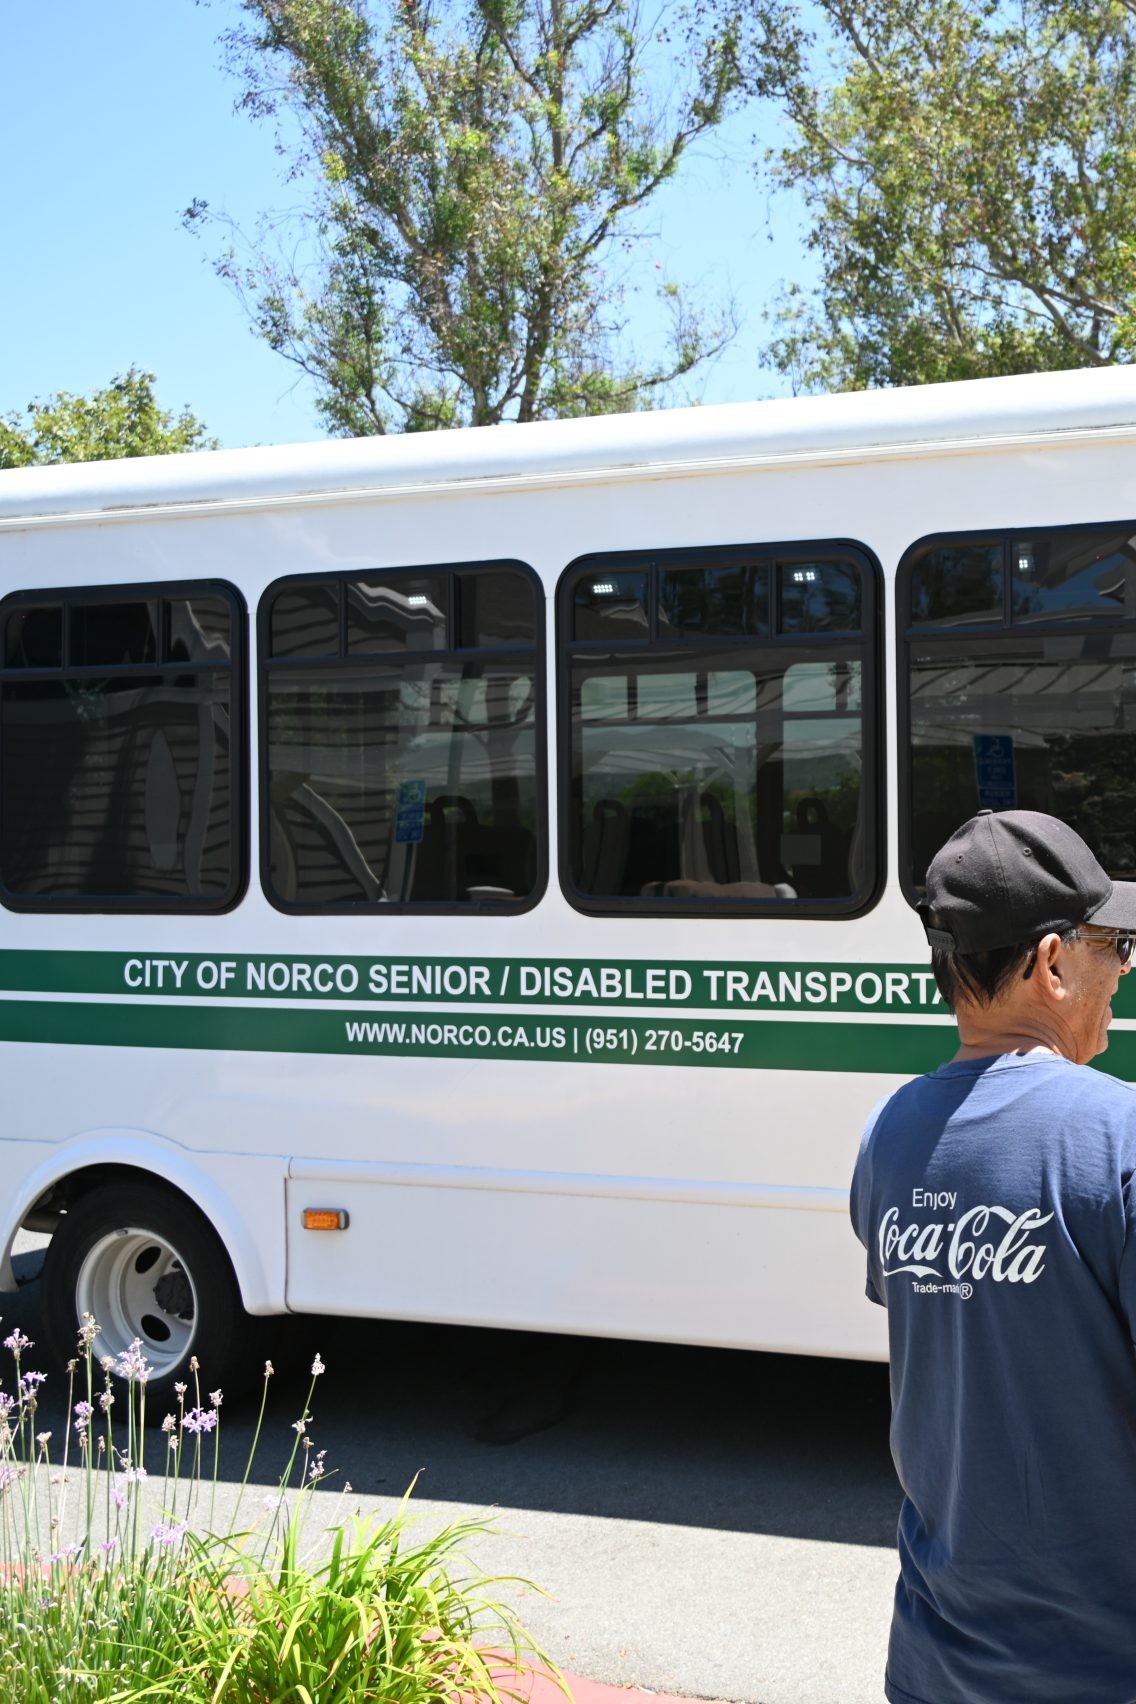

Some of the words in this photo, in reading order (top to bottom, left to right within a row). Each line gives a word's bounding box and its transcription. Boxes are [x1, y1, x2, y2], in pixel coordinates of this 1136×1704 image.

[124, 958, 189, 988] CITY
[196, 960, 237, 990] OF
[246, 961, 359, 993] NORCO
[368, 964, 492, 996] SENIOR
[499, 965, 510, 996] /
[520, 966, 692, 1000] DISABLED
[345, 1022, 566, 1048] WWW.NORCO.CA.US
[585, 1027, 638, 1056] (951)
[644, 1029, 745, 1054] 270-5647
[912, 1187, 958, 1211] Enjoy
[878, 1205, 1055, 1284] Coca-Cola
